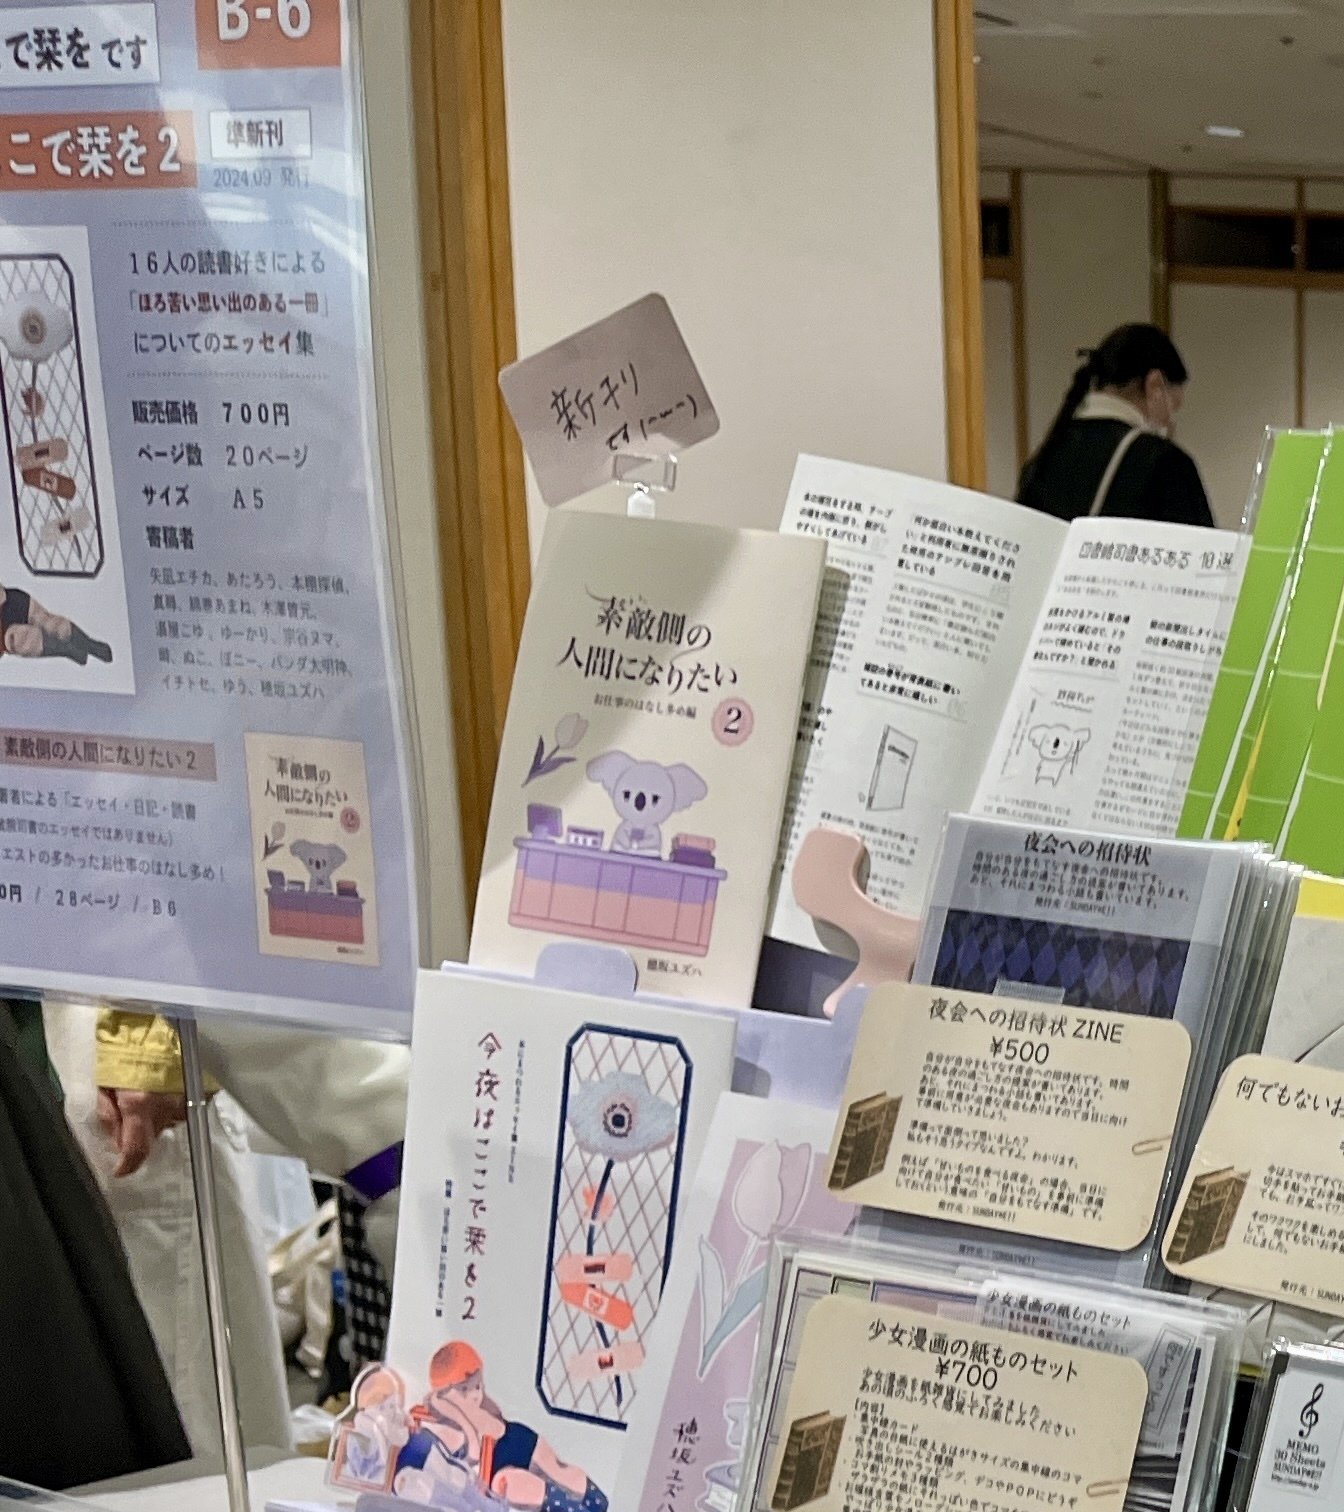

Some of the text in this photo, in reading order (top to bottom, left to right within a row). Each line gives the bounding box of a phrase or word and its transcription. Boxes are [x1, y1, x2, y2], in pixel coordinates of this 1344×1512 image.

[101, 35, 147, 68] です
[133, 331, 315, 356] についてのエッセイ集
[132, 400, 289, 426] 販売価格 700円
[138, 445, 309, 467] ページ数 20ページ
[142, 486, 263, 508] サイズ A5
[597, 594, 712, 649] 素敵側の
[556, 637, 738, 697] 人間になりたい
[1023, 831, 1152, 867] 夜会への招待状
[928, 997, 1125, 1045] 夜会への招待状 ZINE
[990, 1037, 1051, 1066] ¥500
[868, 1317, 1080, 1382] 少女漫画の紙ものセット
[934, 1356, 998, 1392] ¥700
